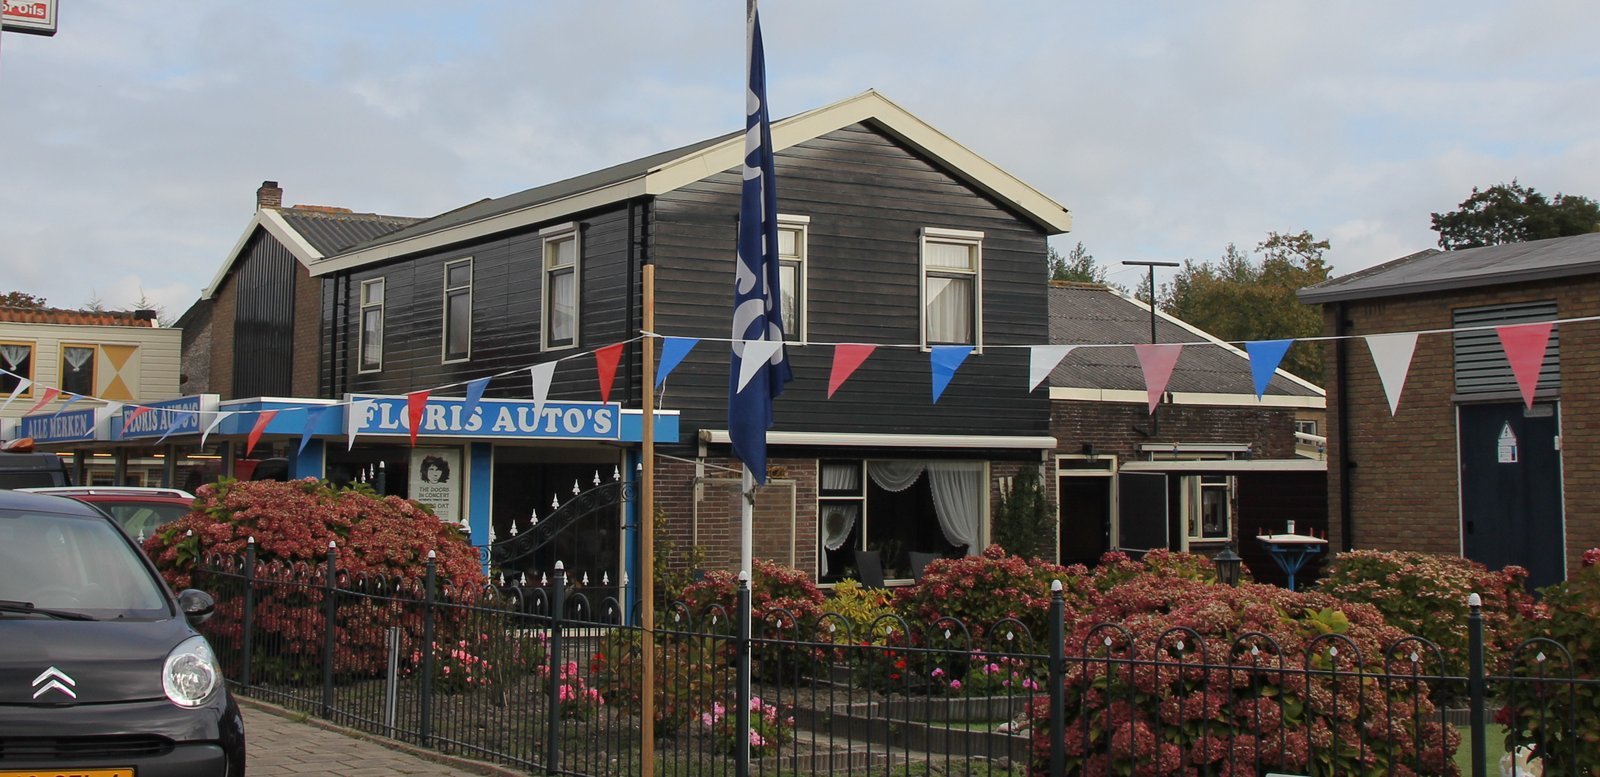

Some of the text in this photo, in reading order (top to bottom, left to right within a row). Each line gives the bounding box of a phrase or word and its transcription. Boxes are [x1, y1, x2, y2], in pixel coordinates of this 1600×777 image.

[18, 4, 45, 16] Oils
[28, 413, 87, 439] ALLE MERKEN
[491, 405, 612, 434] AUTO'S
